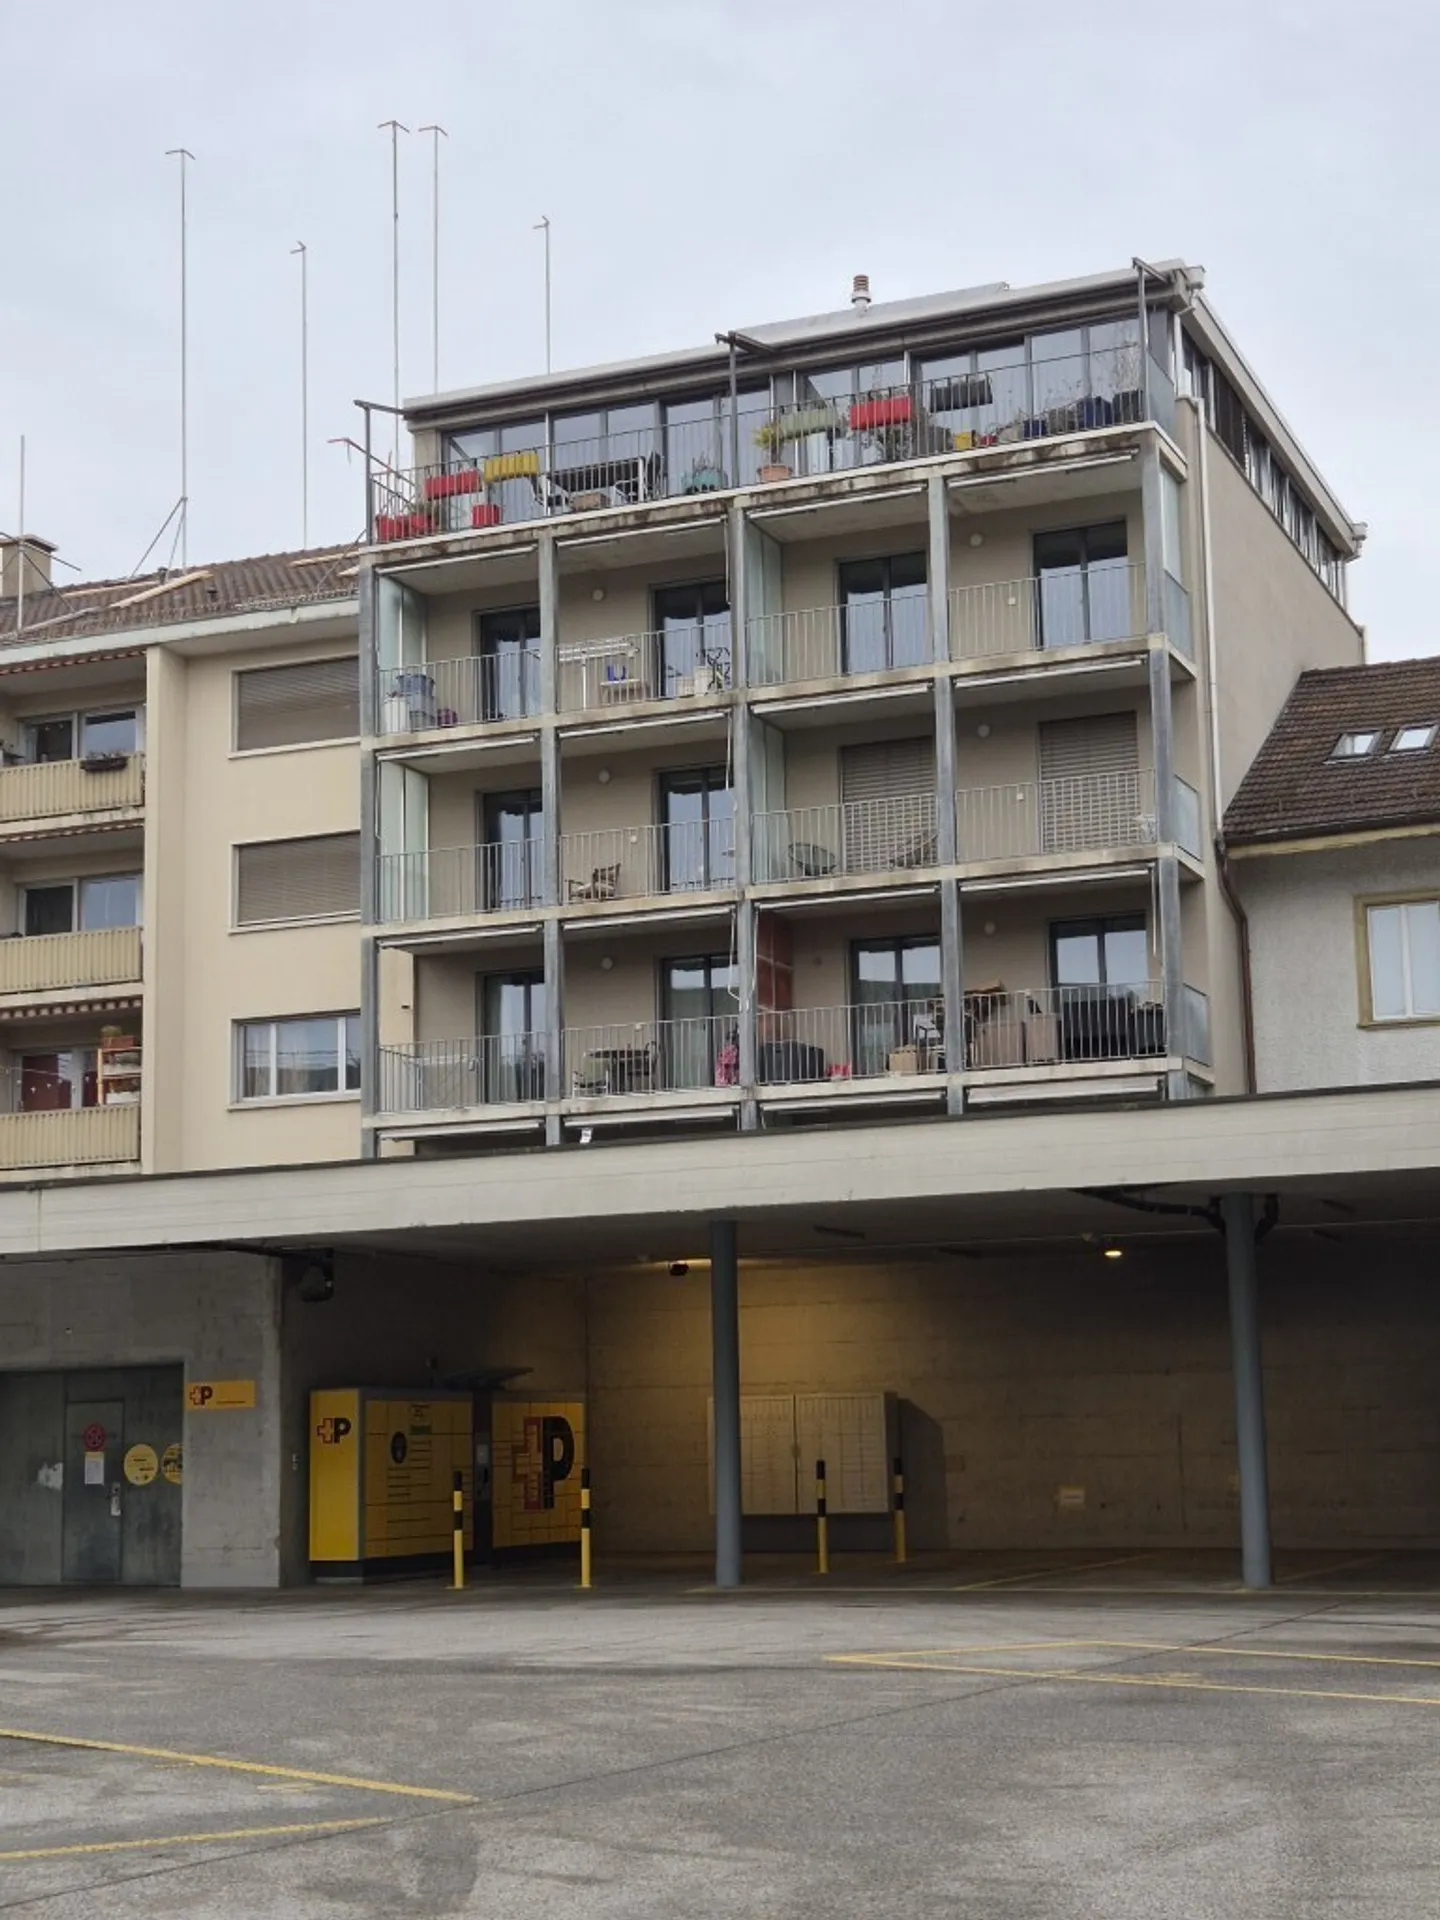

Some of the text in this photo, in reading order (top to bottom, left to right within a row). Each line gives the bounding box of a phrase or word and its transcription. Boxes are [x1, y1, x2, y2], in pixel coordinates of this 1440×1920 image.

[200, 1386, 213, 1405] P
[334, 1417, 352, 1444] P
[542, 1415, 575, 1509] P
